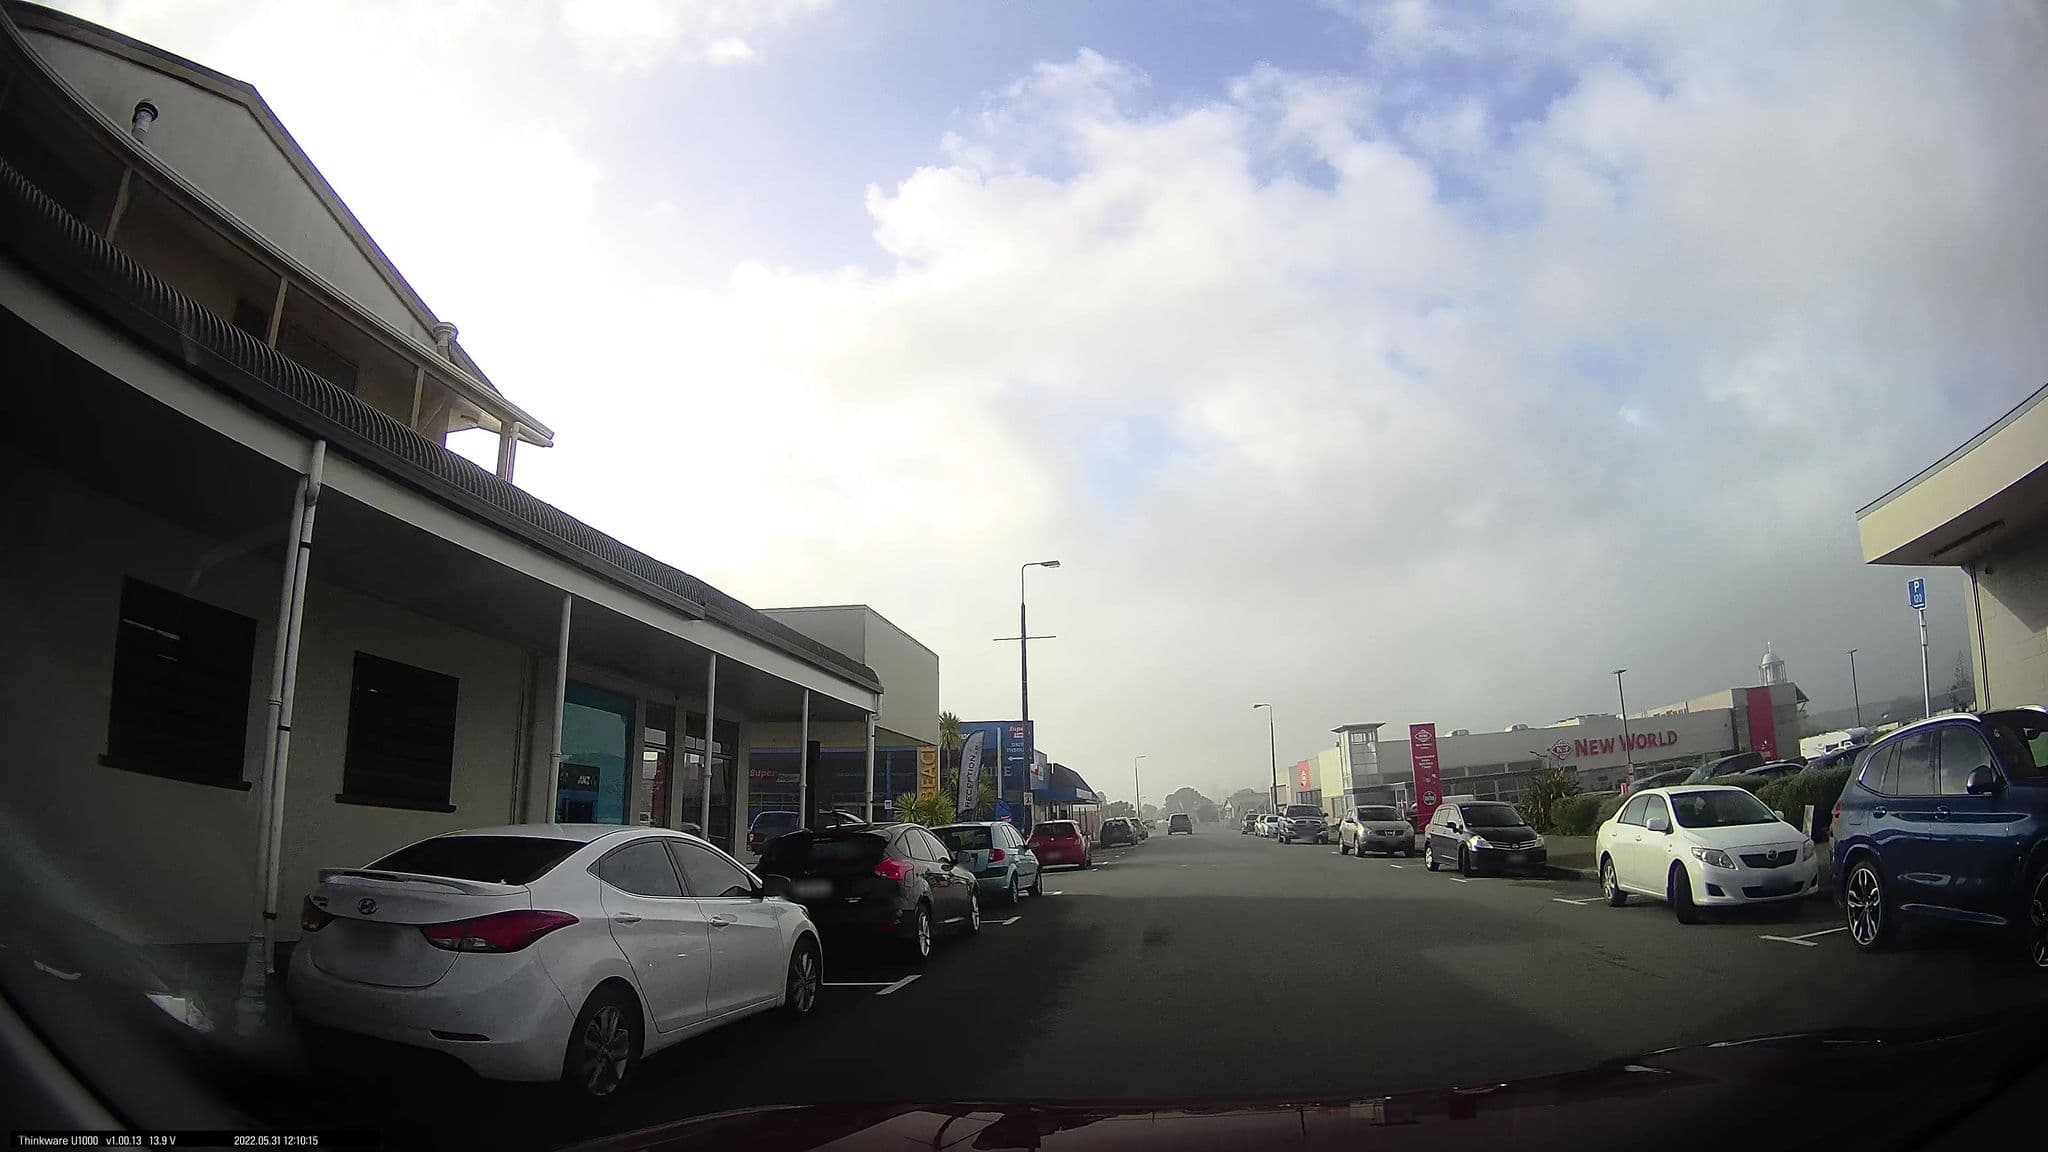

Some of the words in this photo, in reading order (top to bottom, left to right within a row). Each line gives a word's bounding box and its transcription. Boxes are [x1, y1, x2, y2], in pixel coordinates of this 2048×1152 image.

[1914, 581, 1920, 592] P
[1574, 738, 1615, 757] NEW
[1620, 730, 1678, 752] WORLD
[750, 769, 775, 778] Super
[964, 755, 976, 808] RECEPTION
